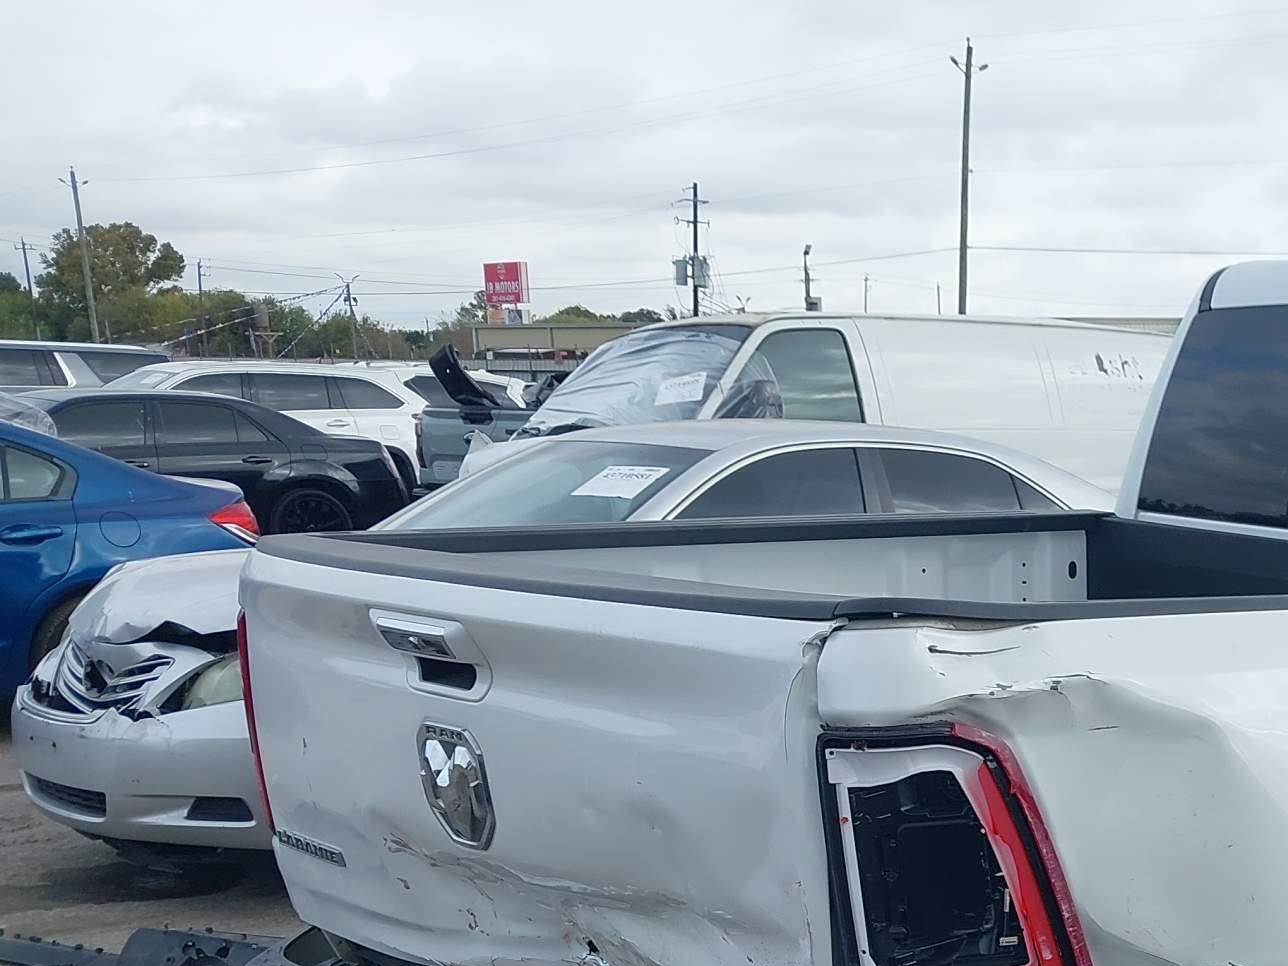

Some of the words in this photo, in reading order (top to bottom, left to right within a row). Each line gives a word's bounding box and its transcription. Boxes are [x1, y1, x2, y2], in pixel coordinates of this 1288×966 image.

[494, 280, 519, 294] MOTORS
[425, 726, 463, 742] RAM
[277, 829, 340, 864] LARAMIE
